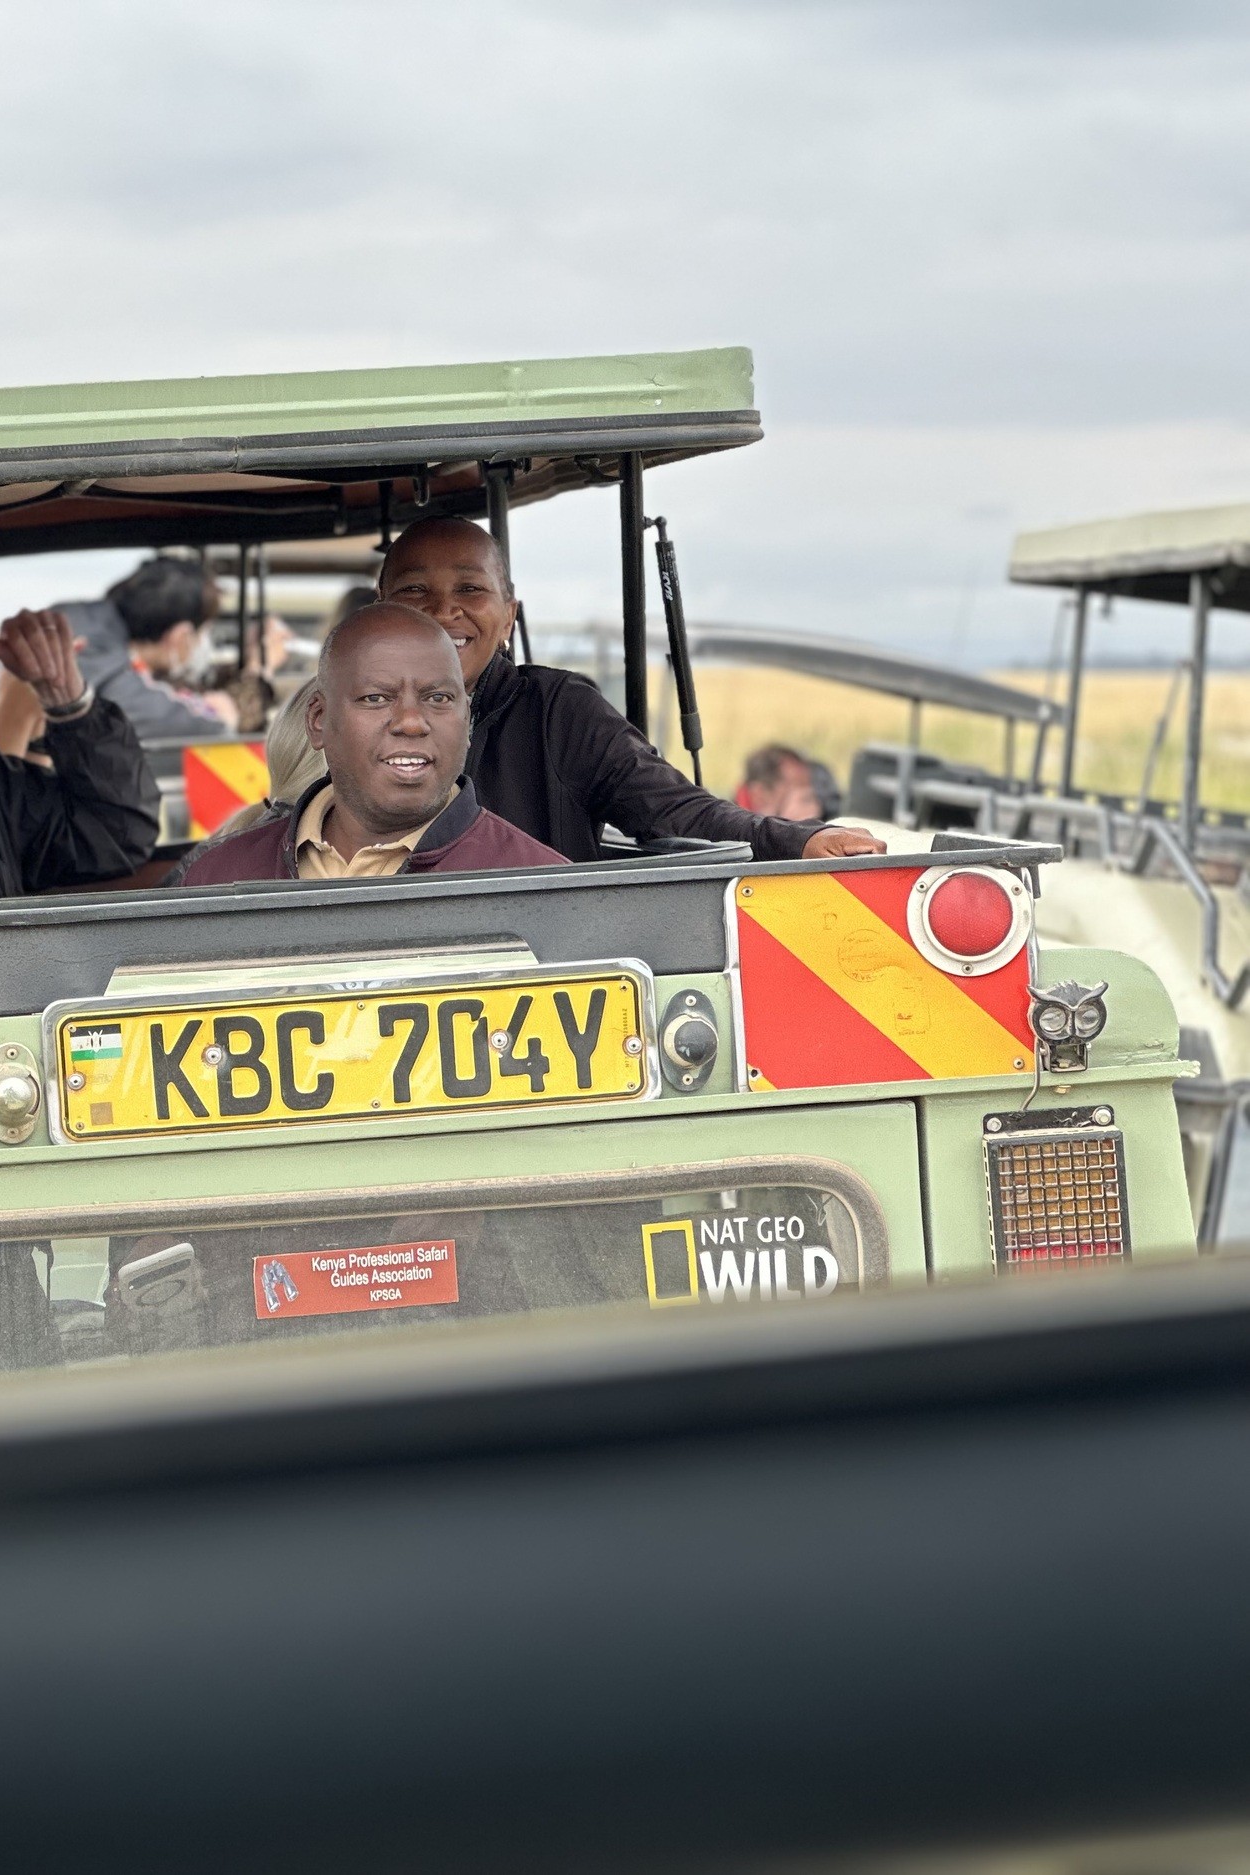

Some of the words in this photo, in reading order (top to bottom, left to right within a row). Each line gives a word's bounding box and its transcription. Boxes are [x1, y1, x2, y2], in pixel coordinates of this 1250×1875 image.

[150, 1011, 335, 1120] KBC
[377, 988, 608, 1104] 704Y
[700, 1217, 748, 1245] NAT
[757, 1215, 805, 1242] GEO
[312, 1256, 346, 1274] Kenya
[348, 1249, 414, 1268] Professional
[417, 1245, 448, 1262] Safari
[331, 1270, 369, 1288] Guides
[371, 1267, 432, 1284] Association
[699, 1245, 839, 1304] WILD
[370, 1288, 403, 1302] KPSGA
